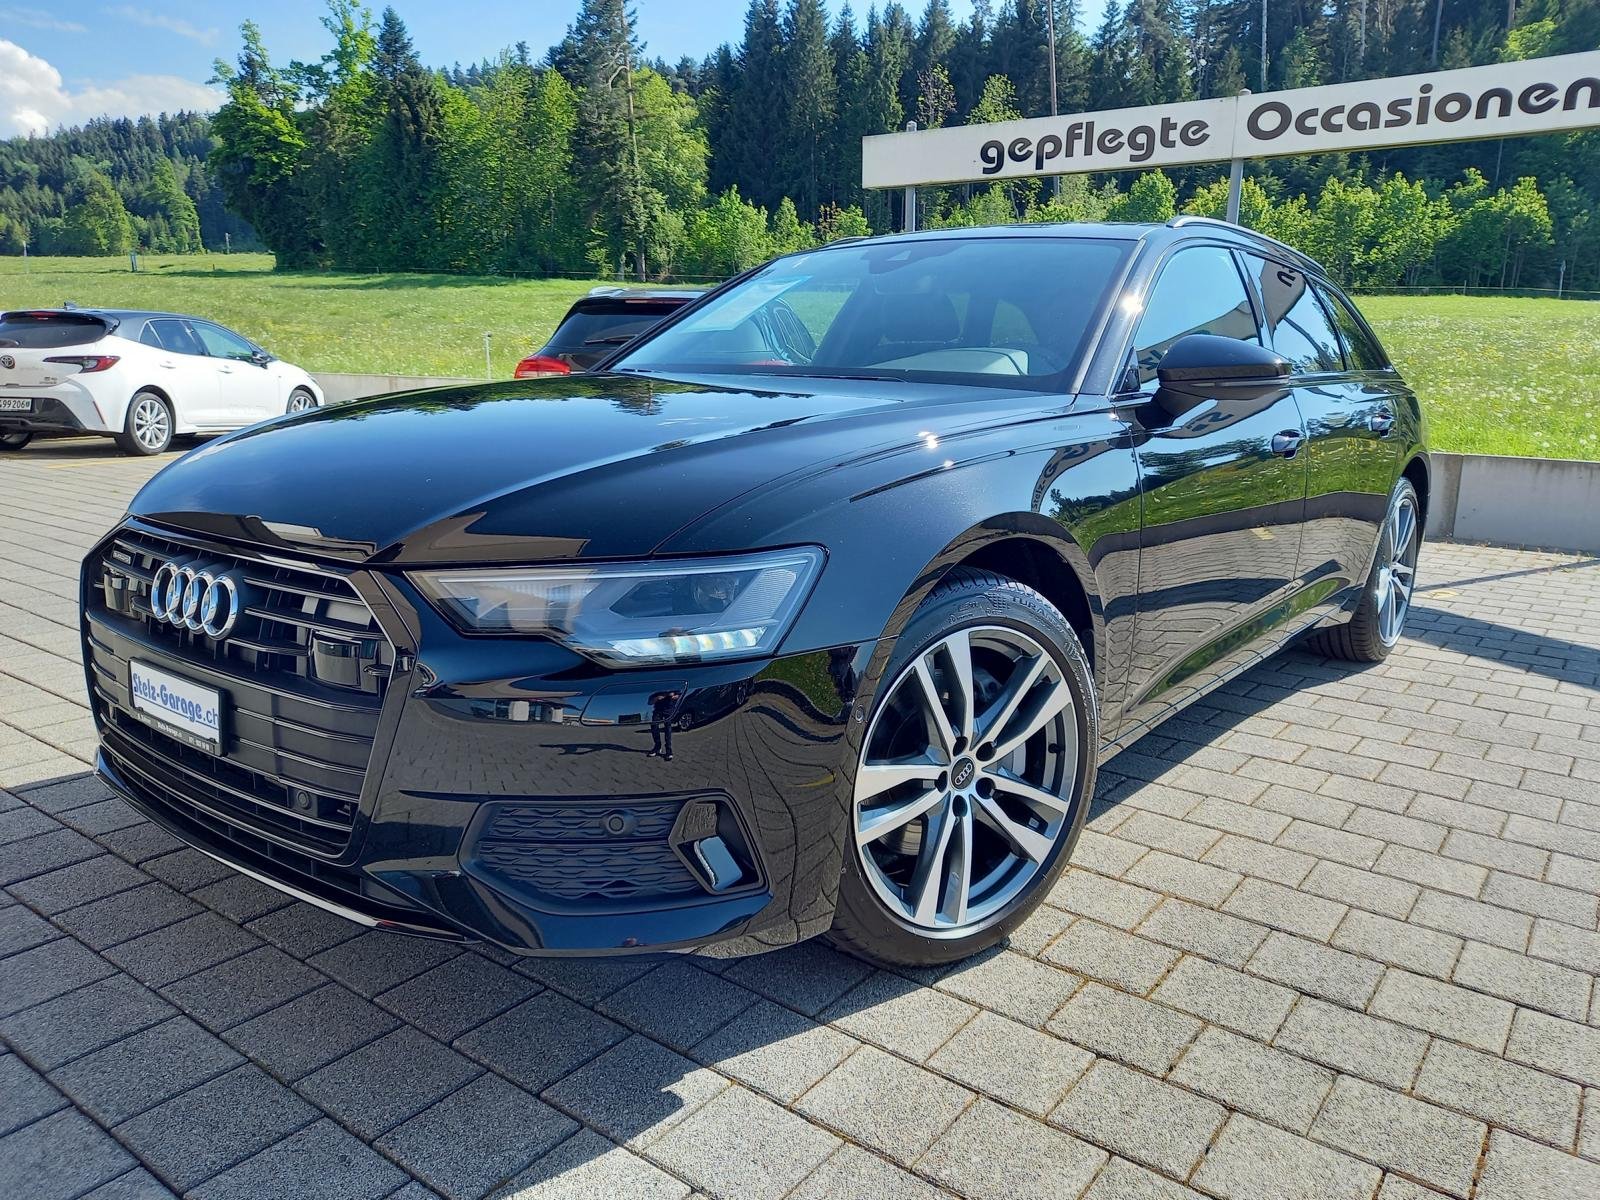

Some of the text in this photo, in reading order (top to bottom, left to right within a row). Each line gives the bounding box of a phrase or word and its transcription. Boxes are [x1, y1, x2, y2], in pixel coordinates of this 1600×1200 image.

[980, 77, 1600, 175] gepflegte Occasionen
[132, 672, 218, 725] Stelz-Garage.ch
